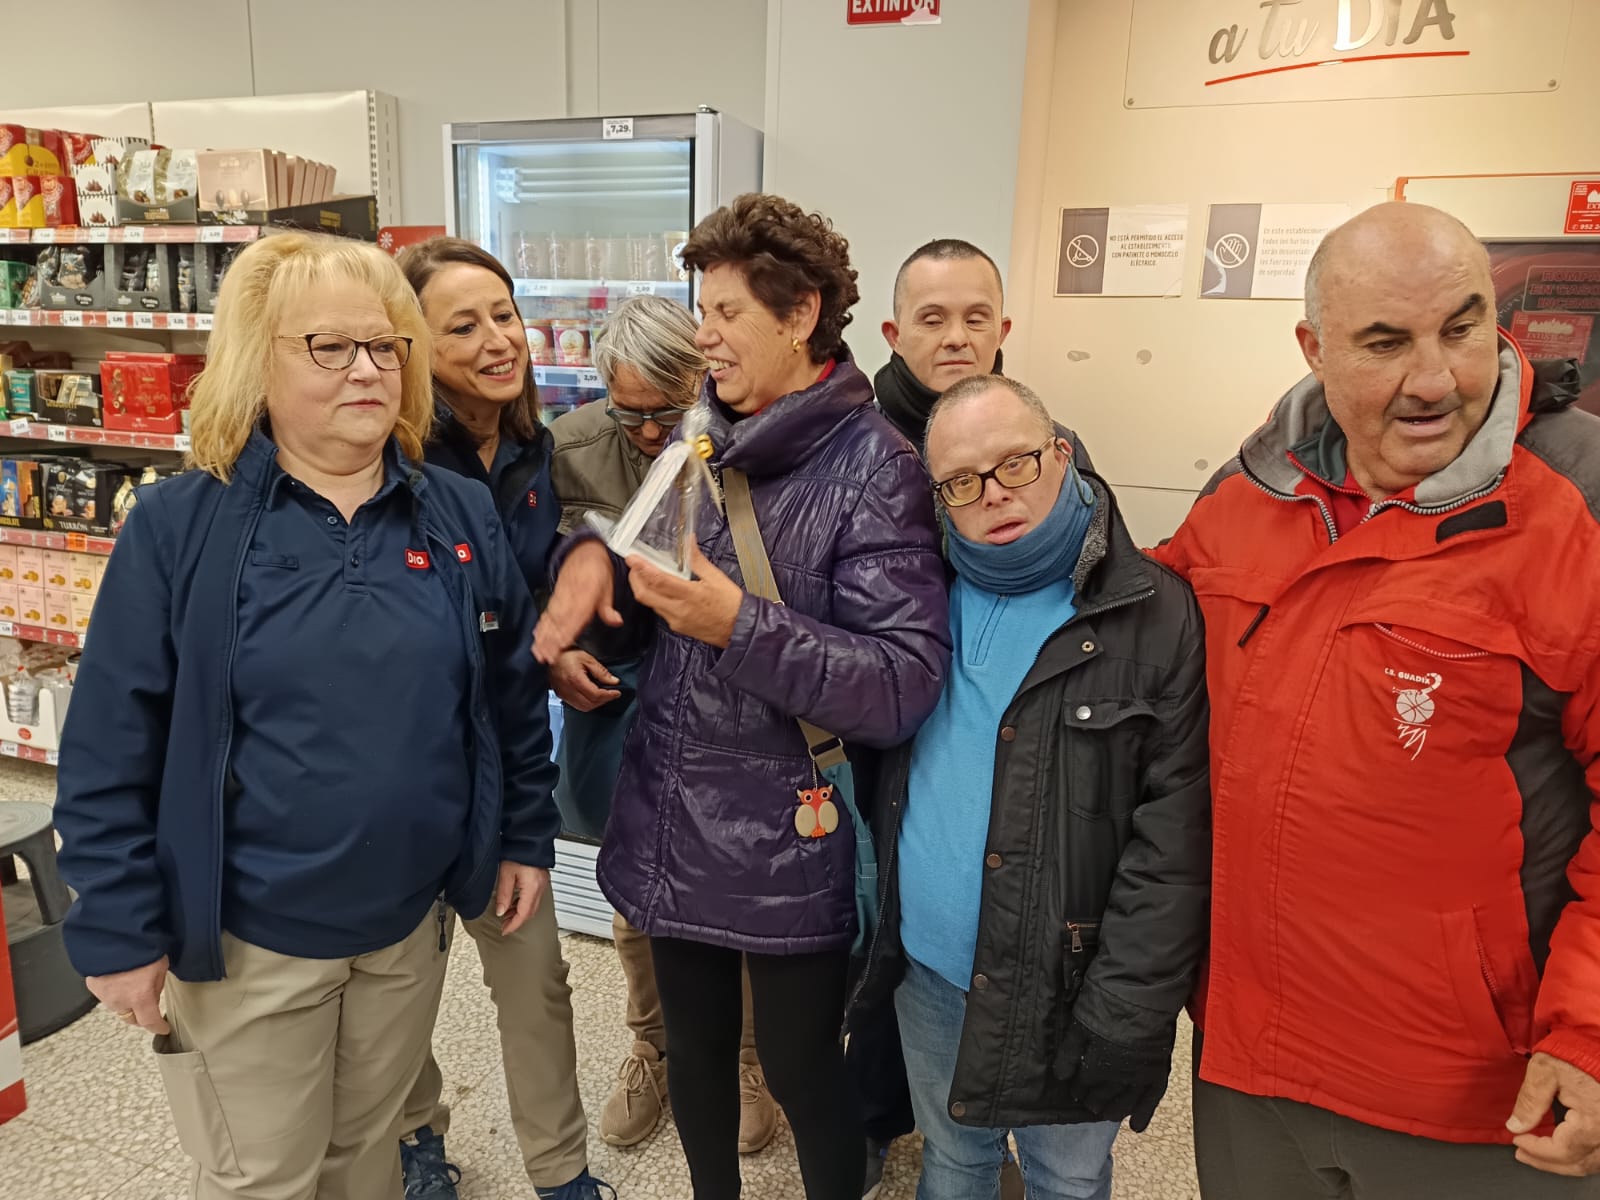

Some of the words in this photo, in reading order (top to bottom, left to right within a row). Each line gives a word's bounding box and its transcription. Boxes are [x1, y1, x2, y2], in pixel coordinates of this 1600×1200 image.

[1208, 23, 1248, 64] a
[407, 552, 424, 564] Dia
[1398, 672, 1430, 684] GUADIX
